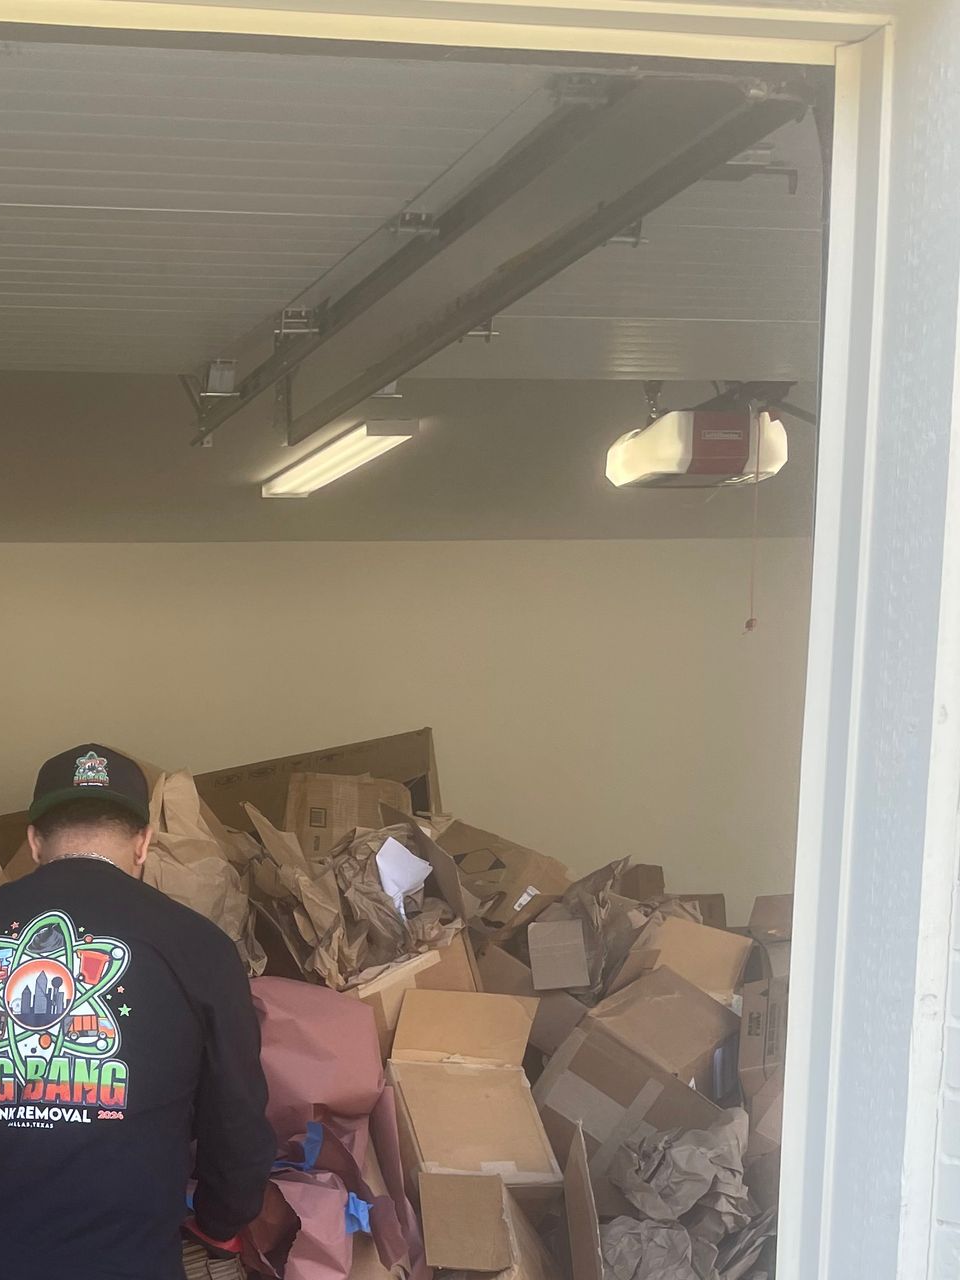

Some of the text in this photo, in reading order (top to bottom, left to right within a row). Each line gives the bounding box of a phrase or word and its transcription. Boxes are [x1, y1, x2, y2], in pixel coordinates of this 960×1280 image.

[22, 1055, 128, 1107] BANG
[16, 1106, 92, 1123] REMOVAL
[97, 1110, 124, 1120] 2024
